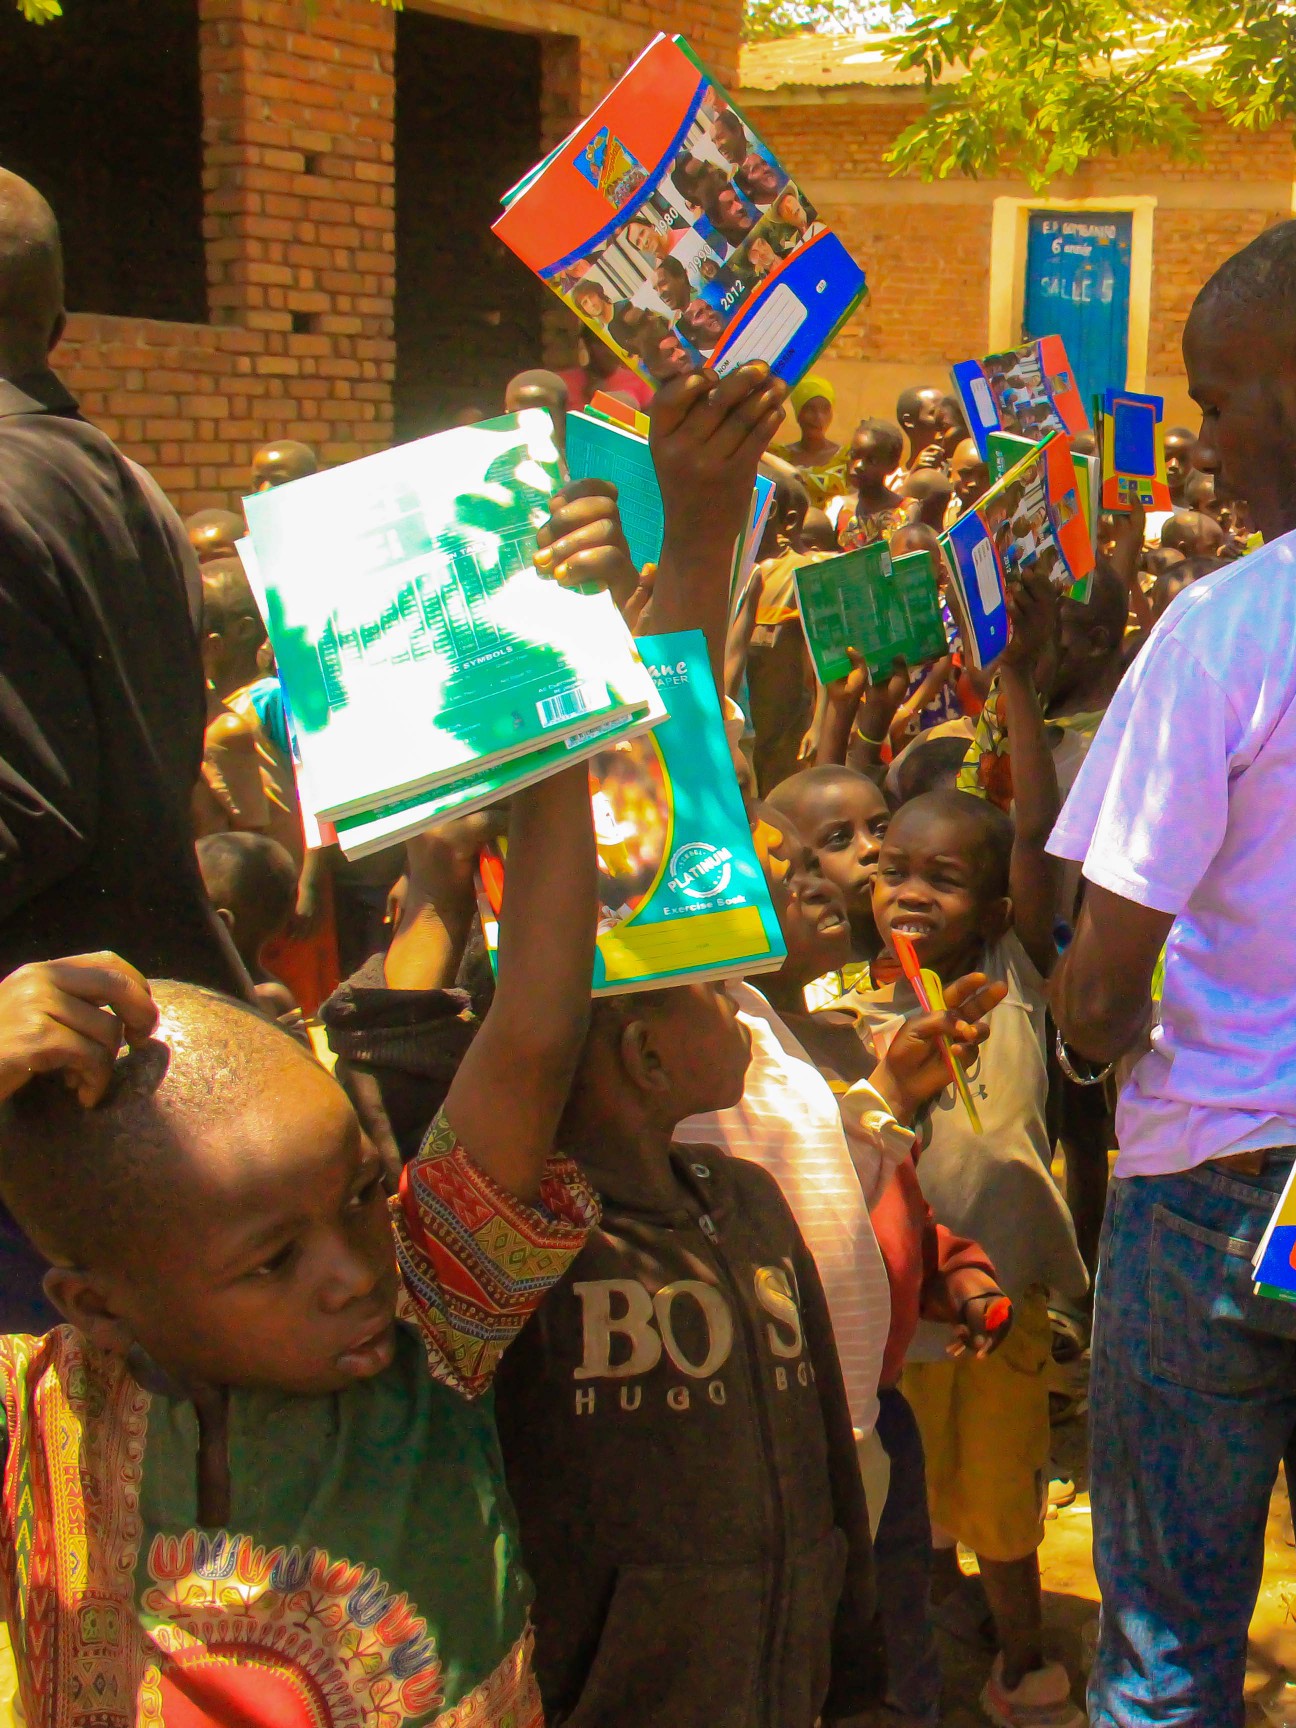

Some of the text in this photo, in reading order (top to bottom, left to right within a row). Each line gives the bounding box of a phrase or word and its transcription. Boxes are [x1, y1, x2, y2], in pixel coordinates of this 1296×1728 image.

[653, 207, 679, 237] 1980
[687, 244, 713, 273] 1990
[719, 279, 746, 311] 2012
[718, 359, 731, 375] NOM
[463, 646, 513, 670] SYMBOLS
[648, 661, 688, 677] ane
[667, 846, 733, 894] PLATINUM
[663, 901, 713, 916] Exercise
[575, 1380, 727, 1416] HUGO
